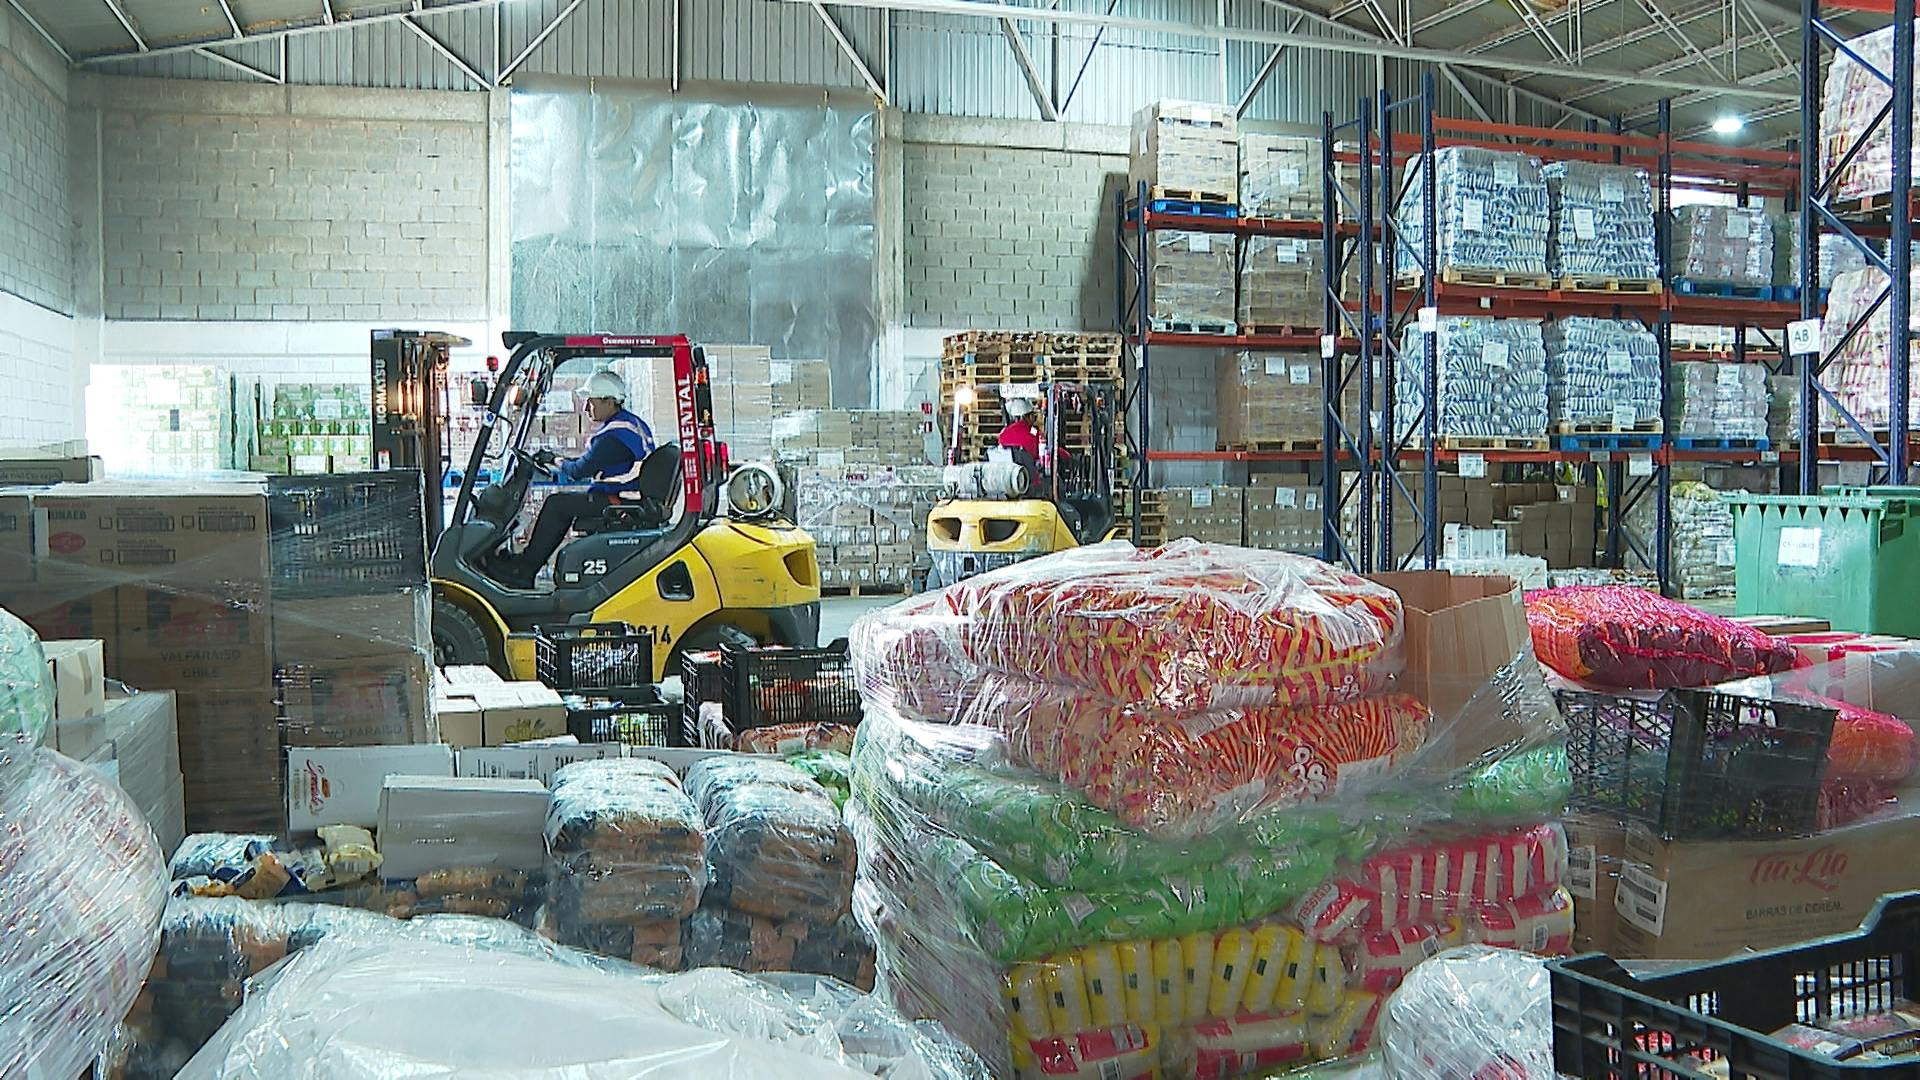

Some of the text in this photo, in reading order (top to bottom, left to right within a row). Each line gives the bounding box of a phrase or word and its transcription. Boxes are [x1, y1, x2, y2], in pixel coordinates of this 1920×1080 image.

[1794, 329, 1809, 342] AB
[375, 358, 388, 425] KOMATSU
[678, 373, 697, 453] RENTAL
[583, 560, 608, 575] 25
[160, 649, 241, 662] VALPARAISO
[1745, 903, 1787, 920] BARRAS
